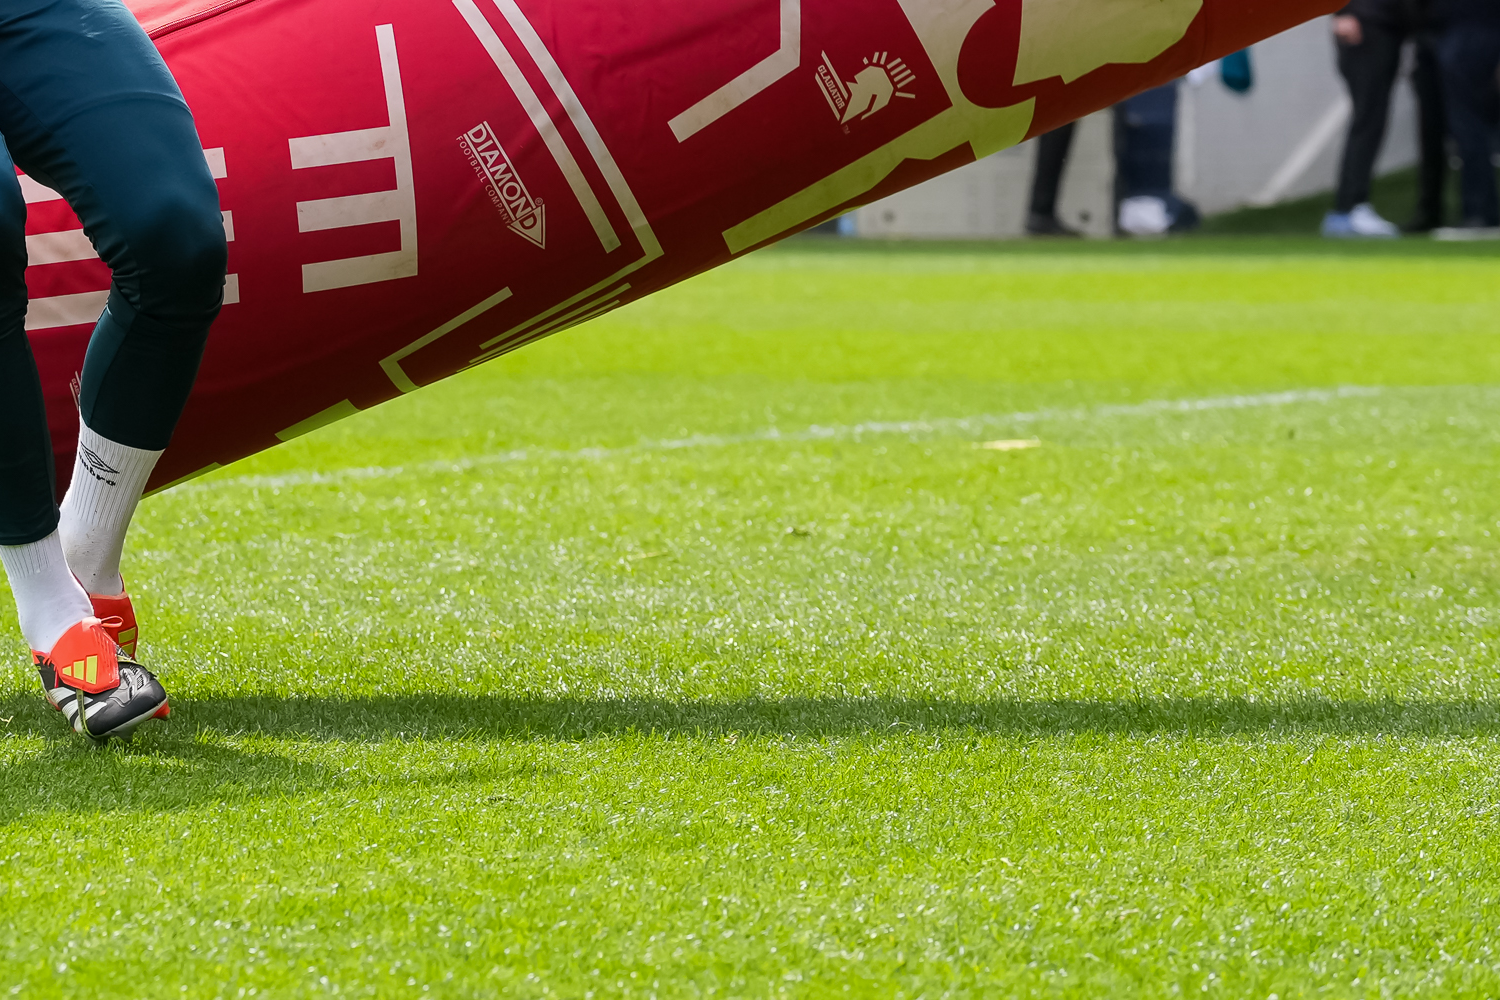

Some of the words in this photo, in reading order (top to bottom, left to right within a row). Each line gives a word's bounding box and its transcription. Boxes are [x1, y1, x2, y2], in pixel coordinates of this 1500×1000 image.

[817, 64, 846, 109] GLADIATOR
[455, 135, 488, 183] FOOTBALL
[484, 184, 512, 225] COMPANY
[467, 123, 538, 230] DIAMOND
